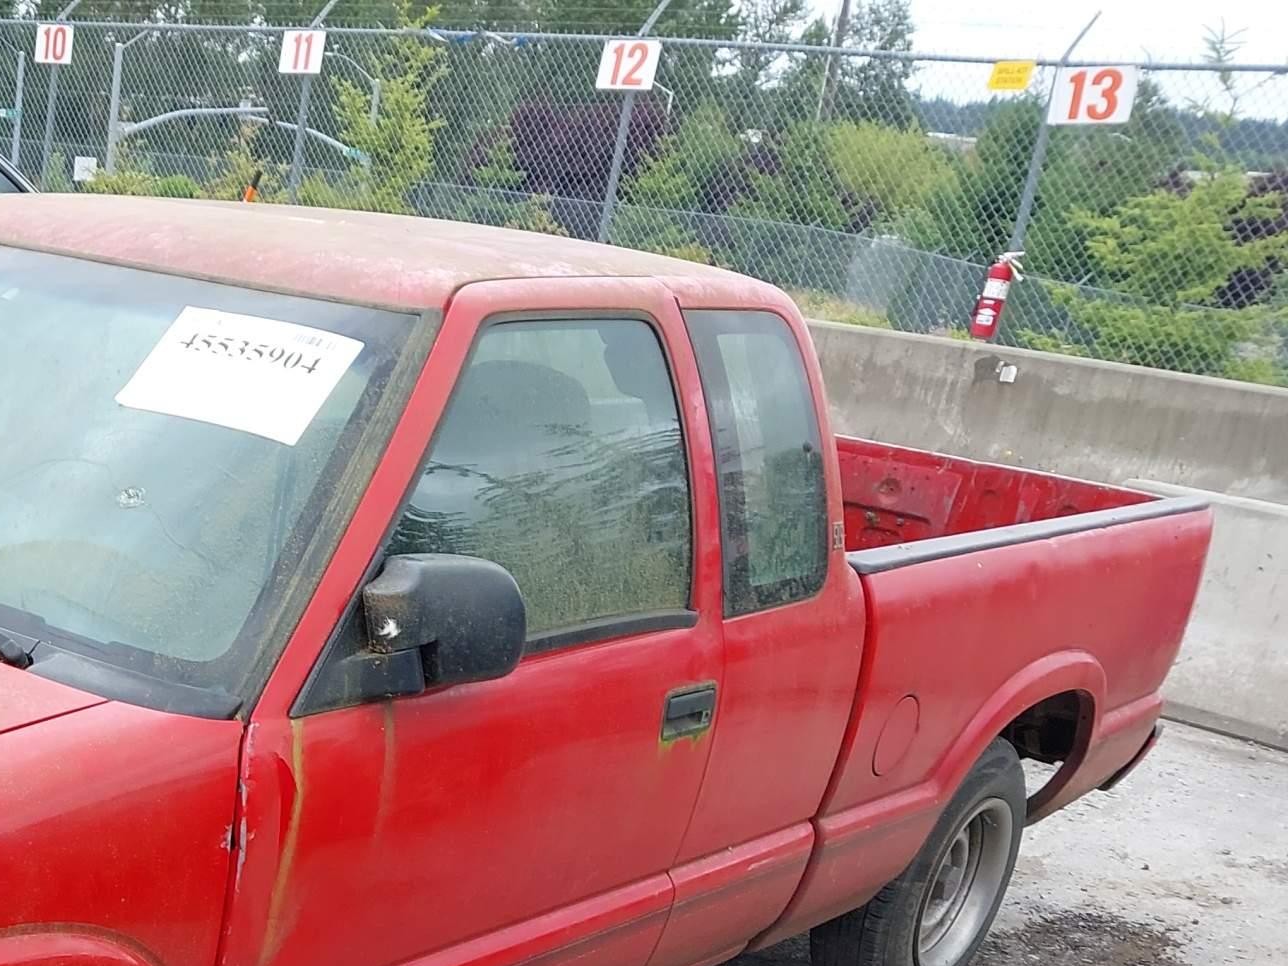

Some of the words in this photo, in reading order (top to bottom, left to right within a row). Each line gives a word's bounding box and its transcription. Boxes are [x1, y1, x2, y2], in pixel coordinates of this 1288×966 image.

[43, 26, 67, 61] 10
[292, 33, 315, 71] 11
[609, 42, 650, 87] 12
[1067, 67, 1124, 121] 13
[179, 331, 322, 375] 45535904
